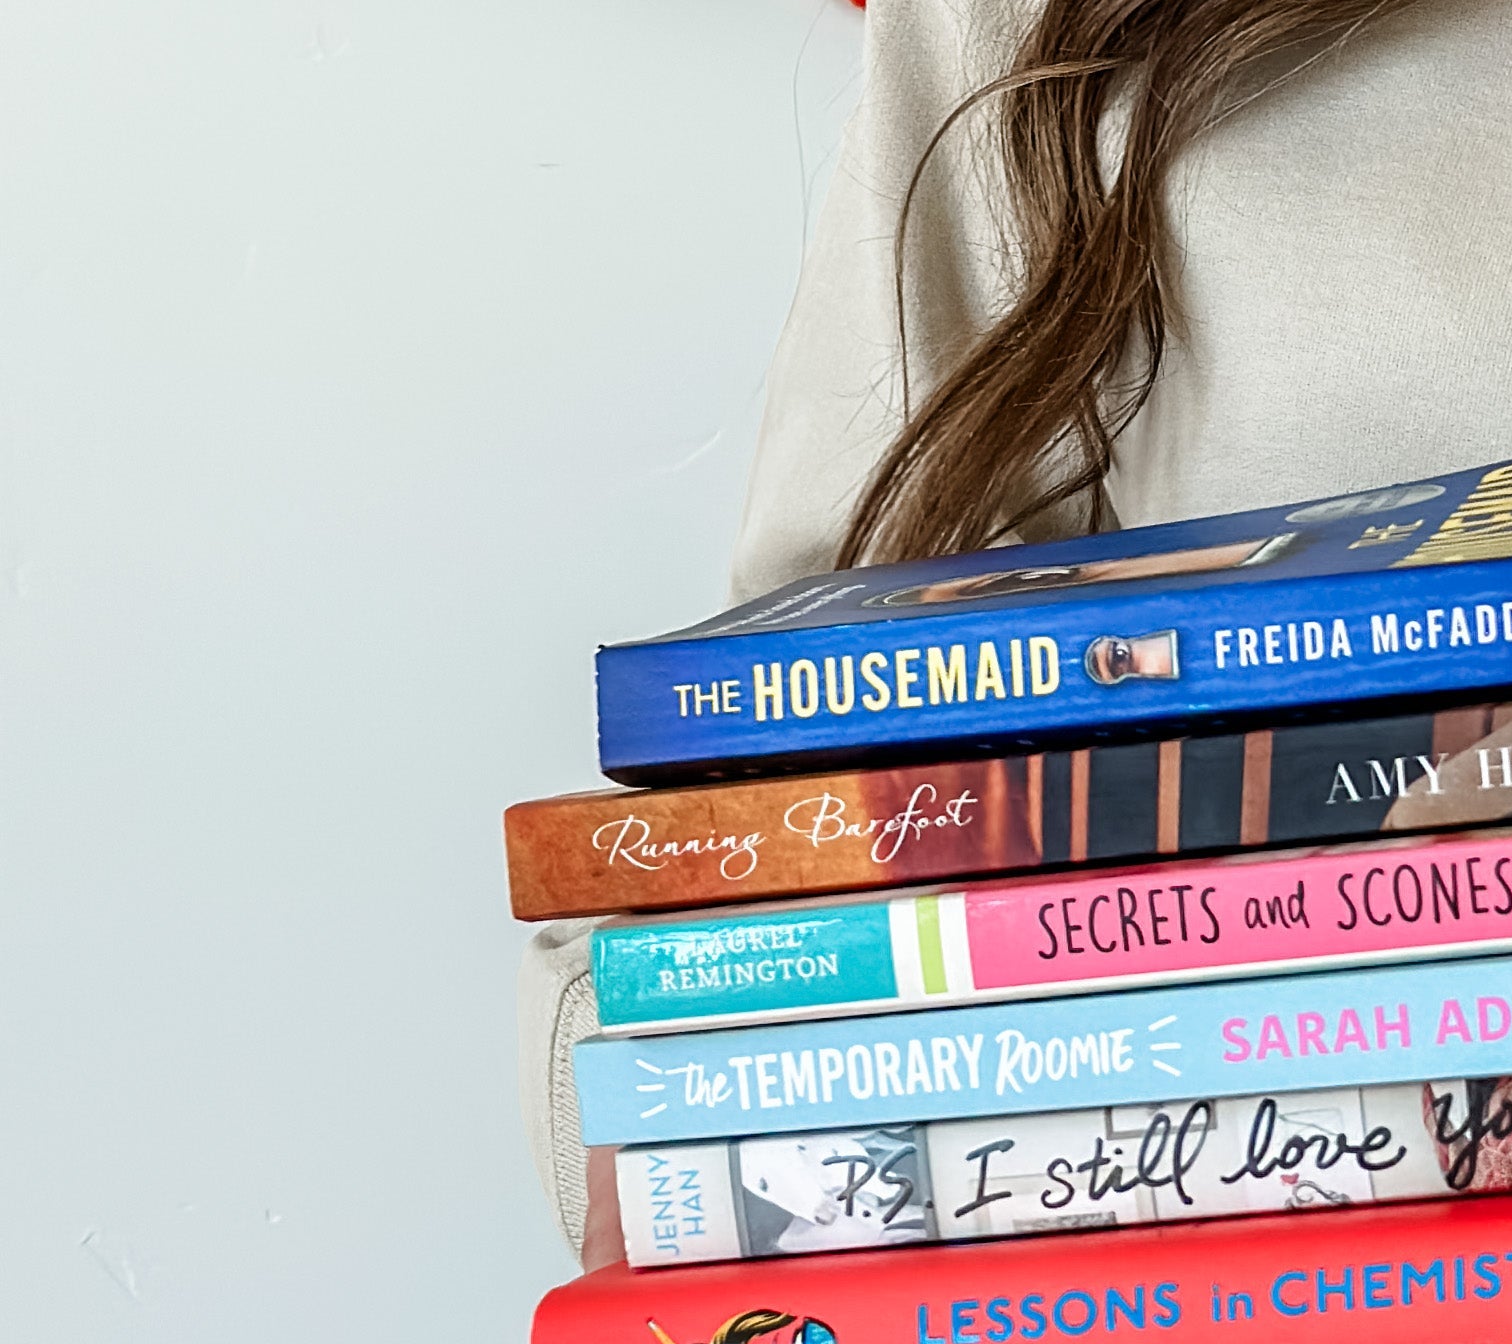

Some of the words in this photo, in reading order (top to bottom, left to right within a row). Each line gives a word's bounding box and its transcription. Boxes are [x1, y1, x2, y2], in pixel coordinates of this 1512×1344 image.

[673, 680, 741, 717] THE
[752, 636, 1060, 722] HOUSEMAID
[1214, 617, 1351, 669] FREIDA
[1326, 753, 1450, 805] AMY
[592, 814, 767, 880] Running
[784, 782, 978, 864] Barefoot
[1038, 884, 1221, 960] SECRETS
[1243, 880, 1310, 931] and
[659, 954, 839, 992] REMINGTON
[1221, 1002, 1412, 1062] SARAH
[665, 1061, 735, 1110] the
[728, 1033, 986, 1112] TEMPORARY
[954, 1138, 1017, 1218] I
[1040, 1101, 1216, 1209] still
[1221, 1098, 1408, 1184] love
[647, 1154, 680, 1256] JENNY
[678, 1169, 706, 1236] HAN
[1210, 1283, 1254, 1323] in
